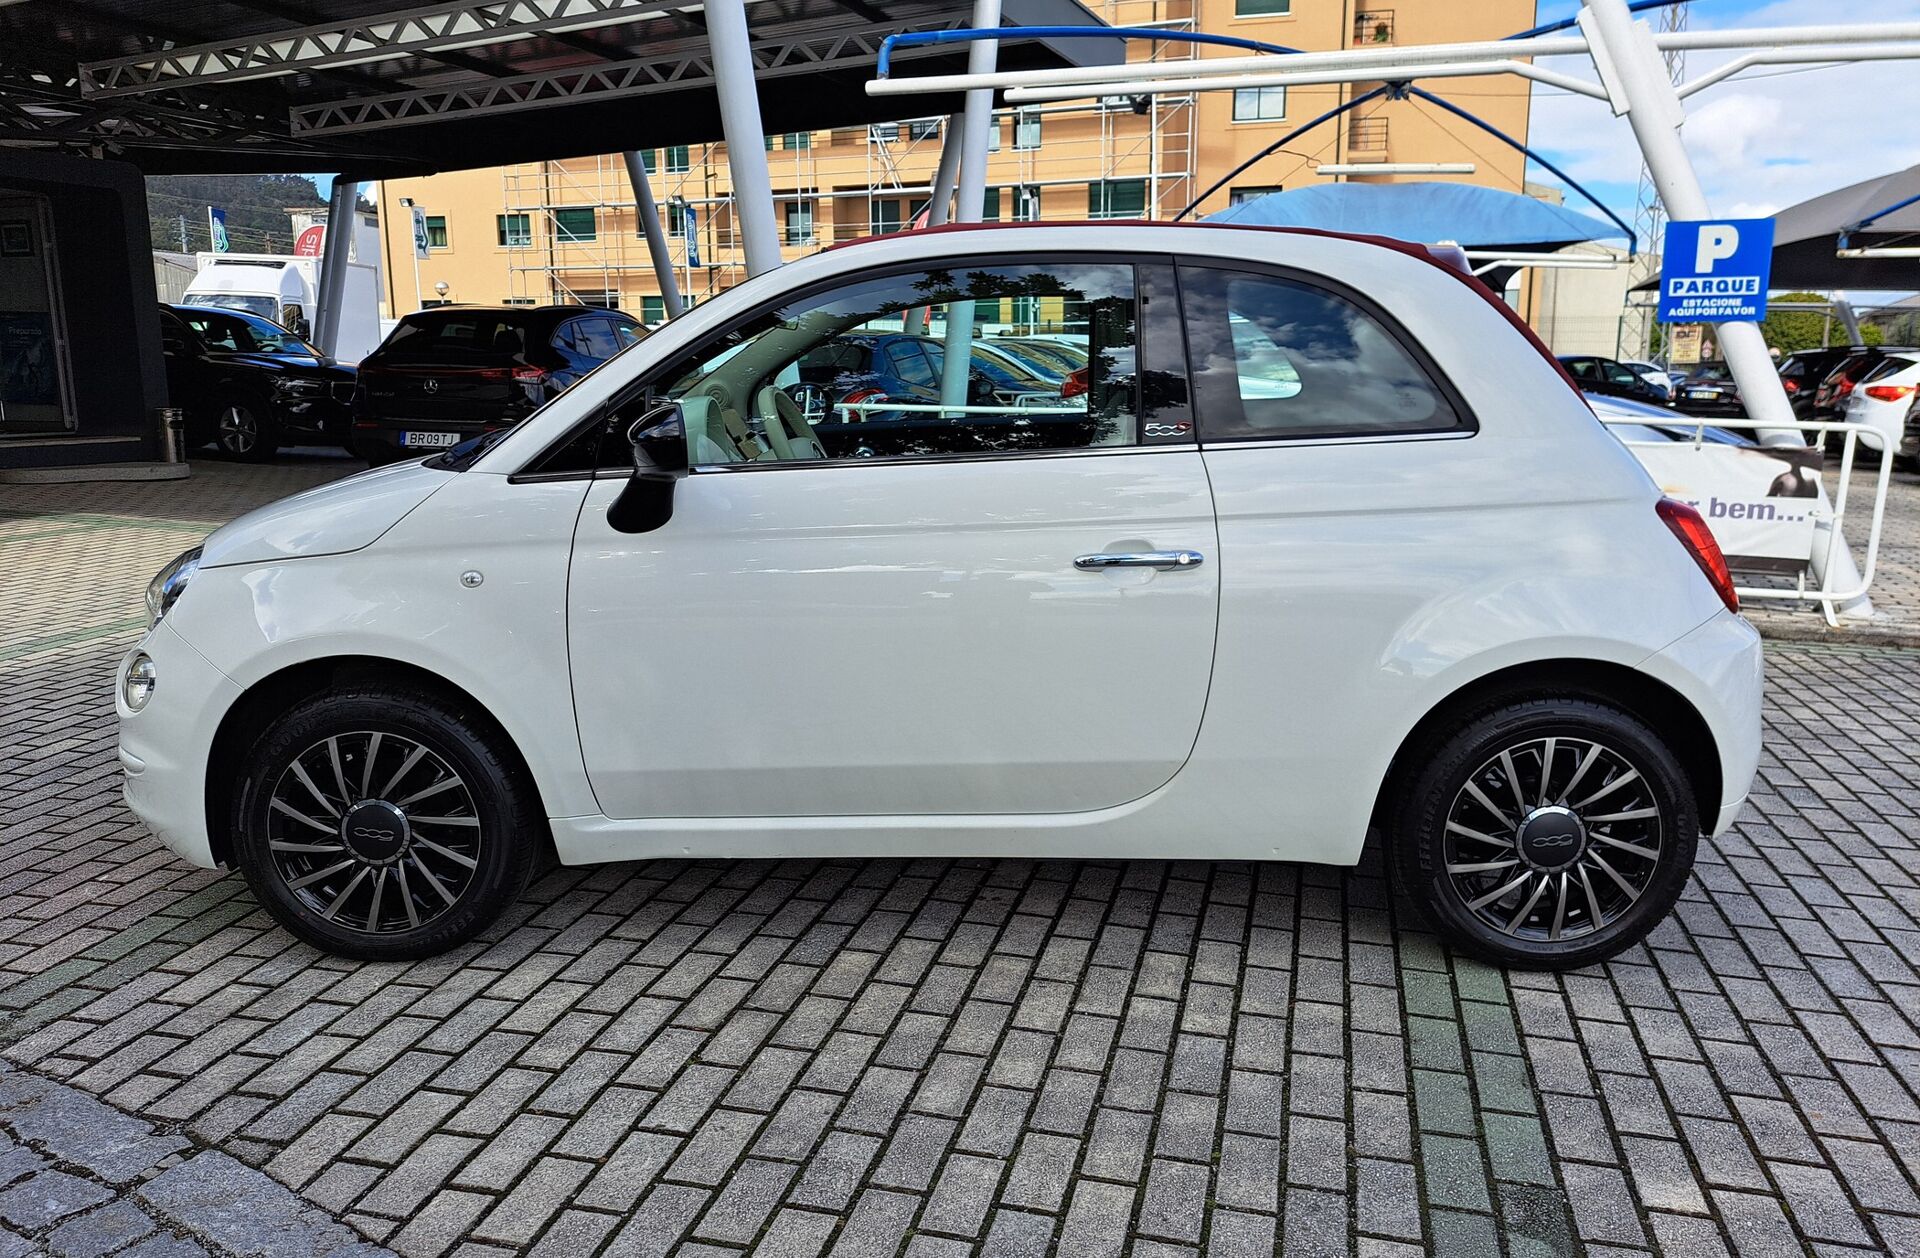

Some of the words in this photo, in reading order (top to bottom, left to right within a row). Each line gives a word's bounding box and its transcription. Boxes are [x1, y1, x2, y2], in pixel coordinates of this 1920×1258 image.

[1695, 224, 1739, 273] P
[1672, 278, 1756, 295] PARQUE
[1682, 297, 1743, 308] ESTACIONE
[1668, 308, 1695, 317] AQUI
[1695, 307, 1717, 316] POR
[1718, 306, 1756, 316] FAVOR
[1708, 497, 1804, 522] bem...
